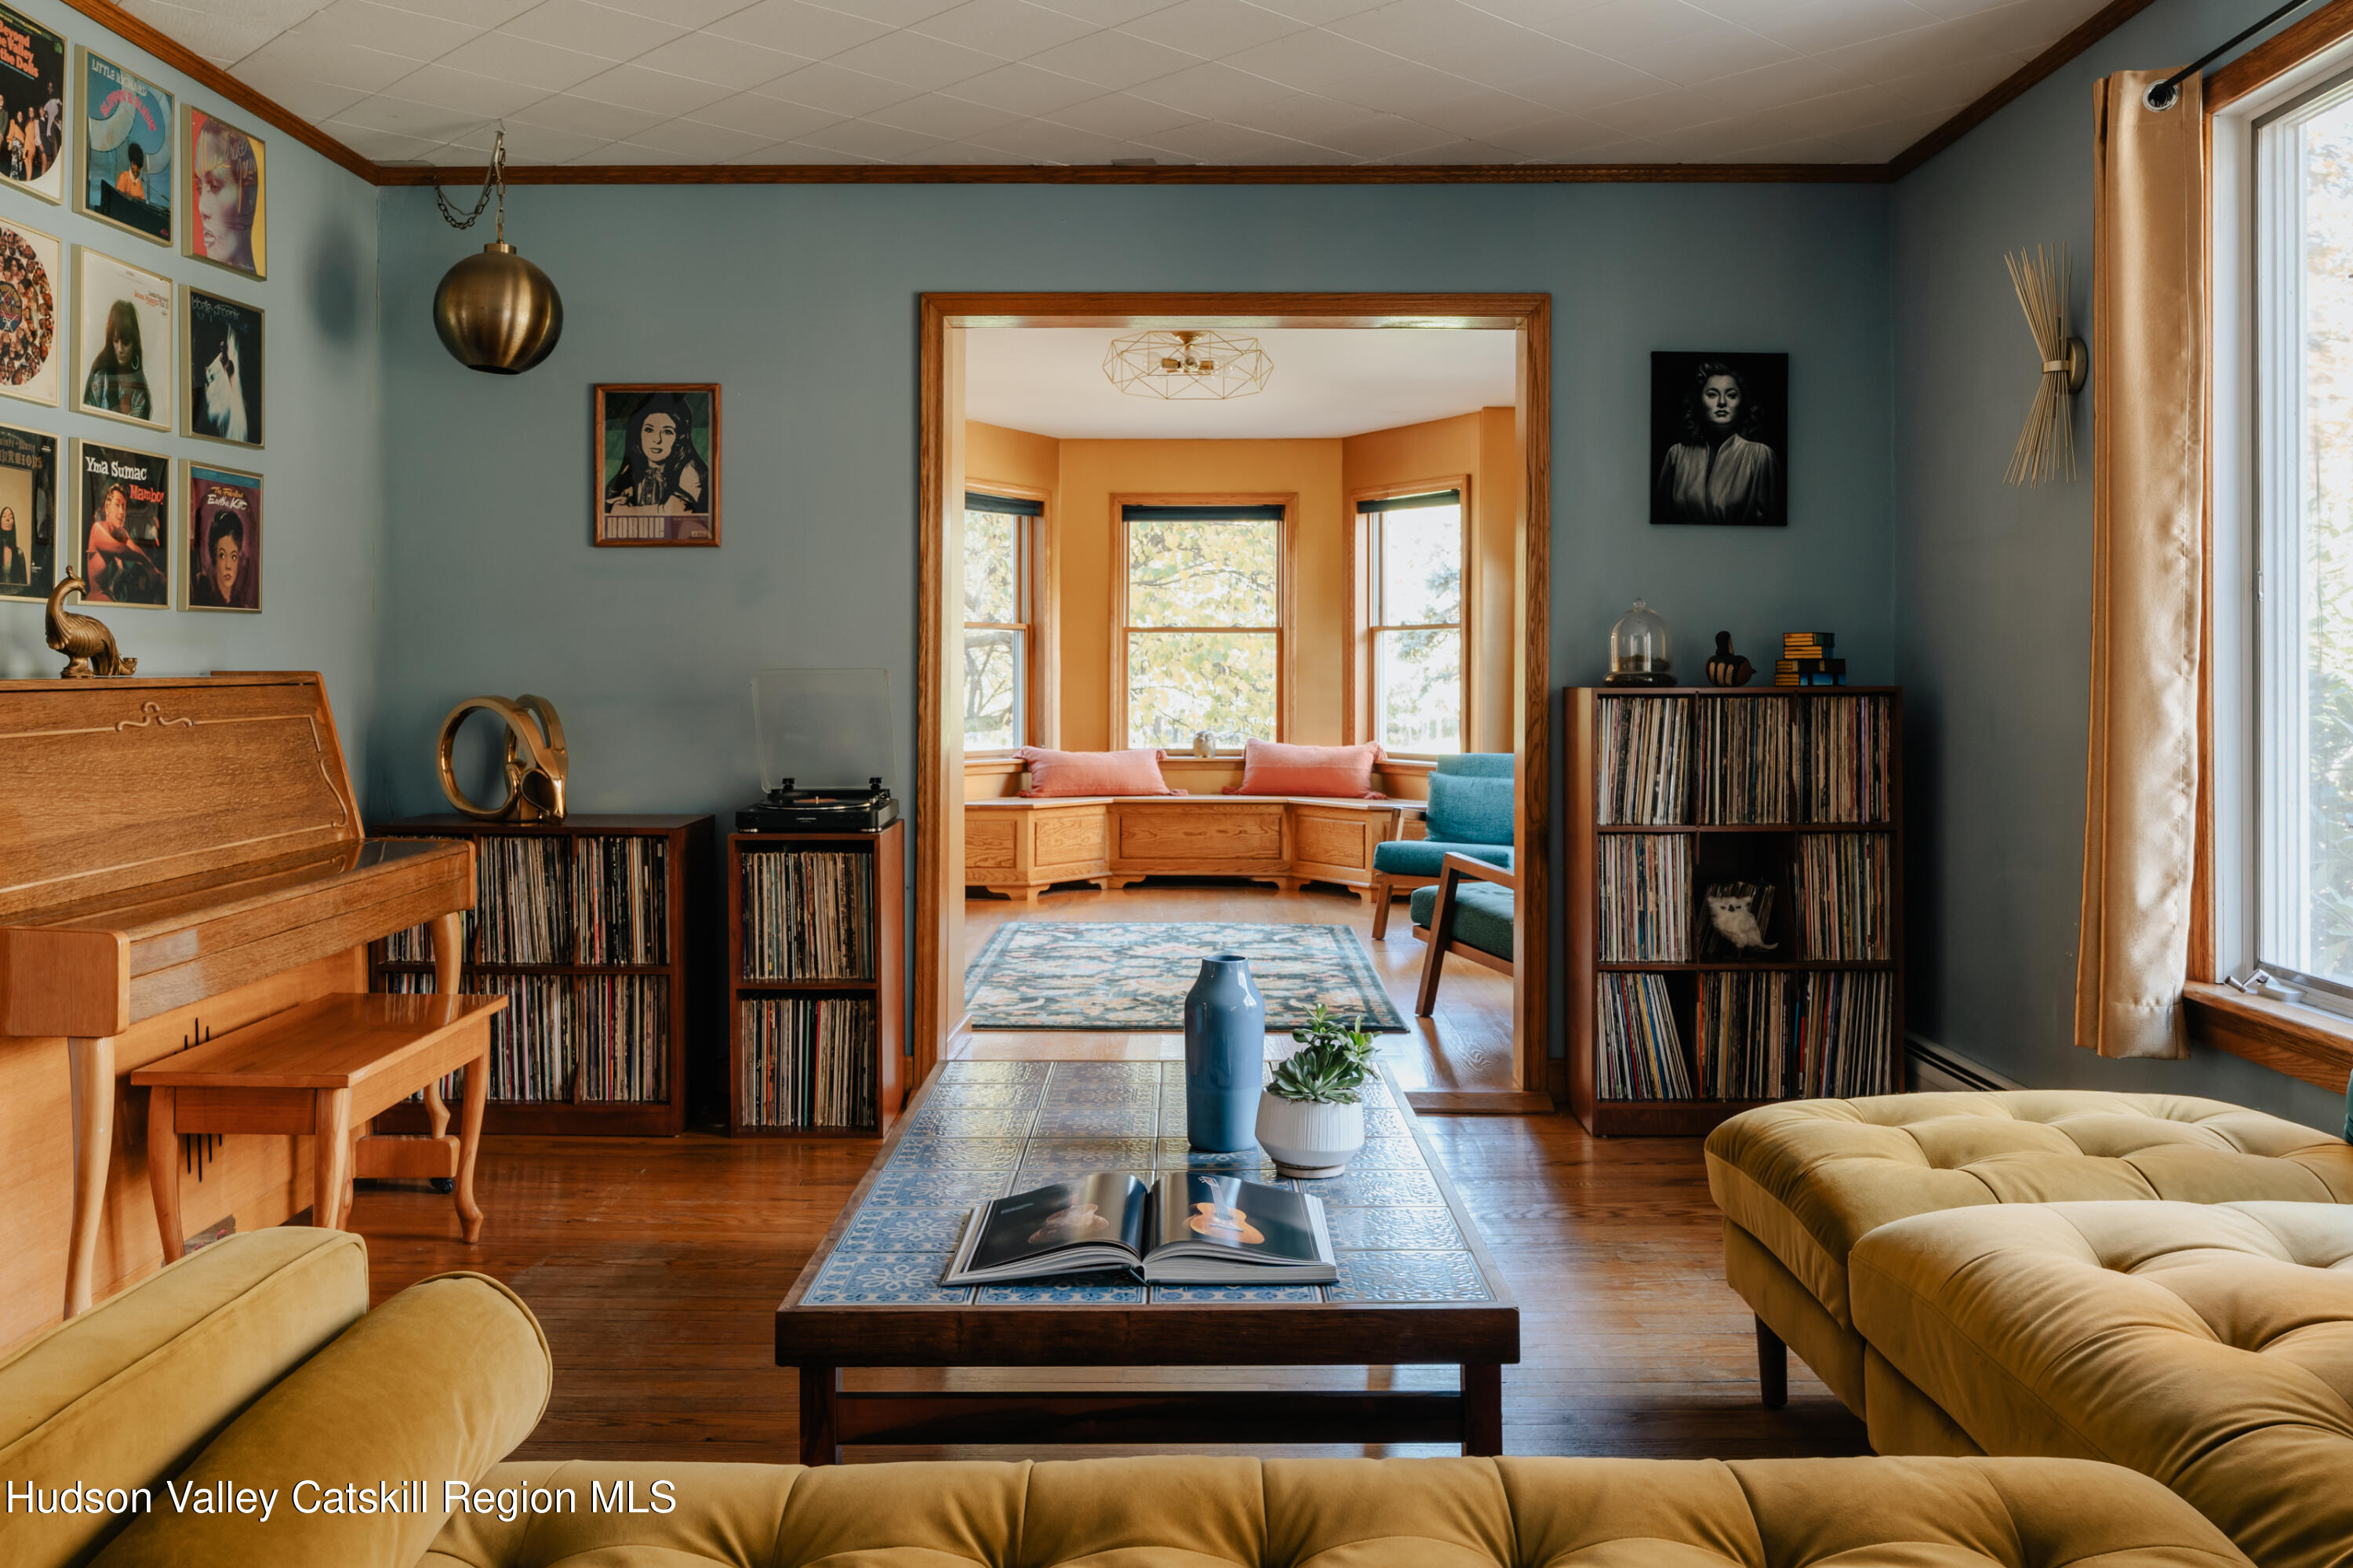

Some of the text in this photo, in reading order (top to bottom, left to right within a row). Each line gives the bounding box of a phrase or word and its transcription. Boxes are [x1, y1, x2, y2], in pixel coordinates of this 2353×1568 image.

[7, 34, 34, 62] Valley
[16, 54, 39, 78] Dolls
[91, 58, 115, 80] LITTLE
[85, 456, 147, 481] Yma Sumac
[129, 483, 164, 506] Mambo!
